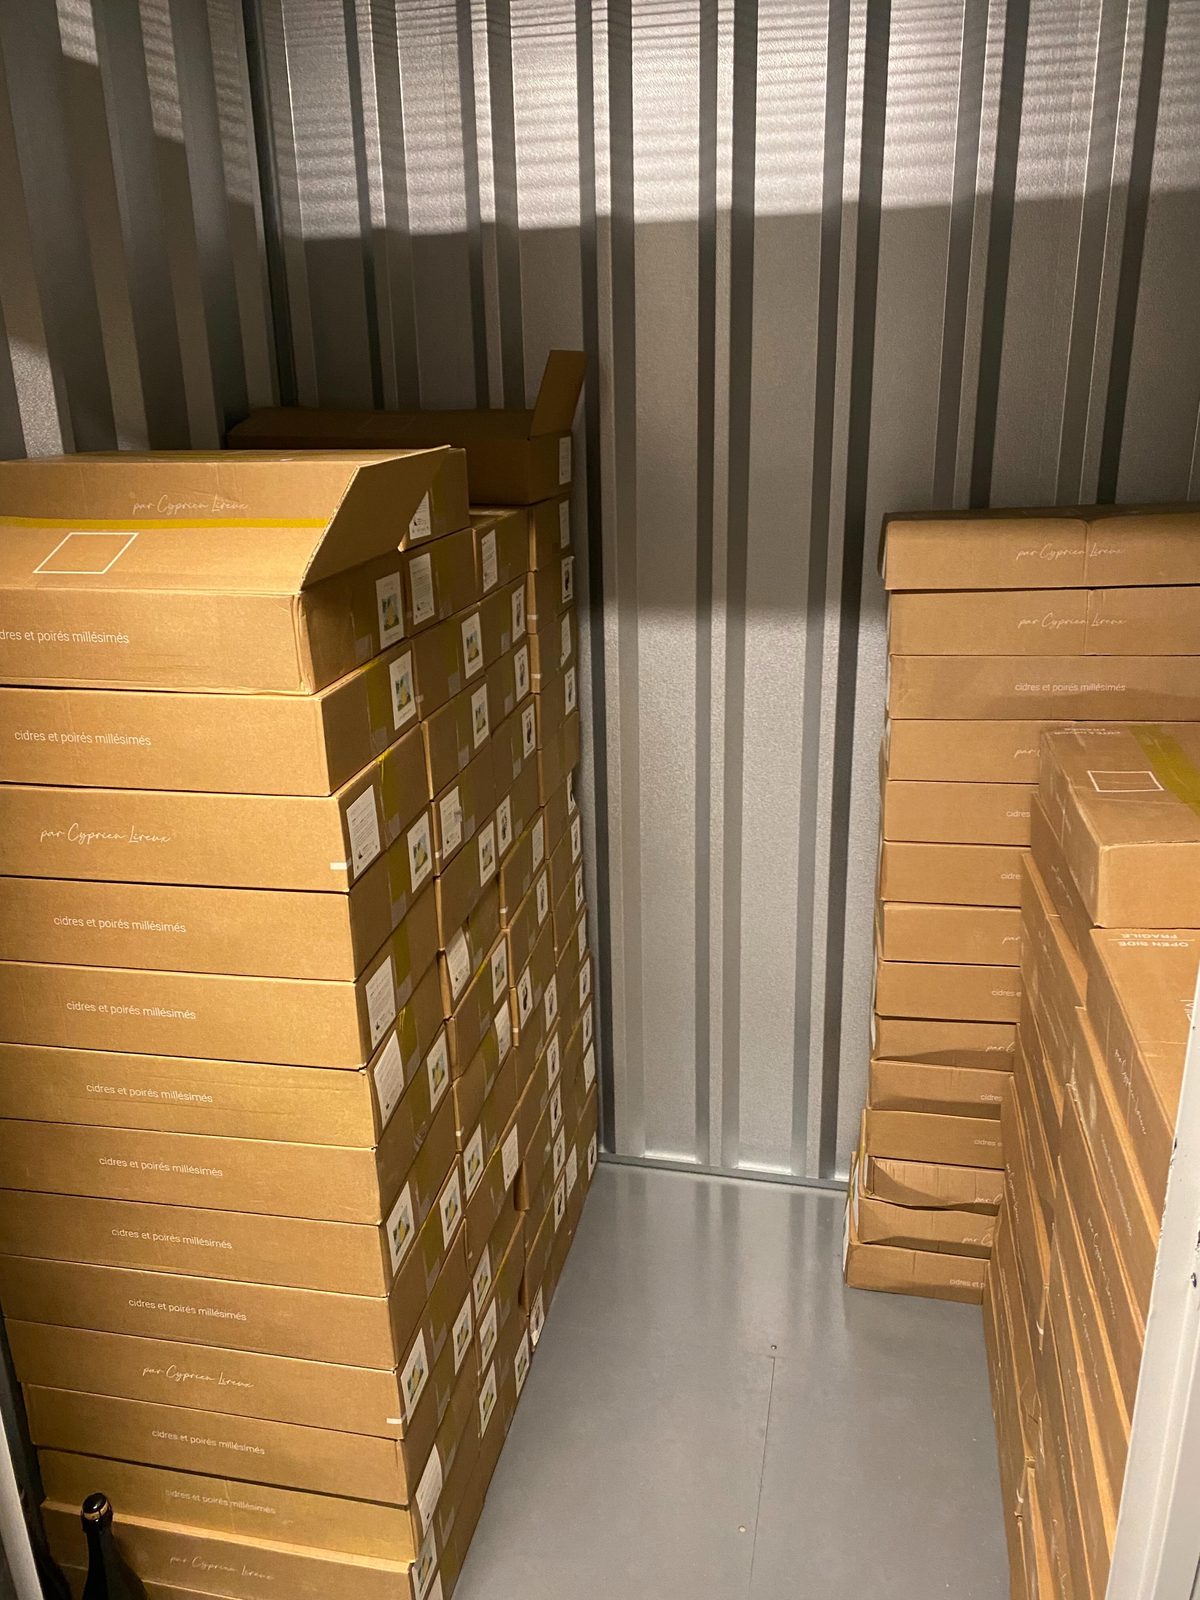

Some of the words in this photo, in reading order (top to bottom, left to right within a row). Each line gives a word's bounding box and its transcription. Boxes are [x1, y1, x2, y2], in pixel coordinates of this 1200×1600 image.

[132, 501, 155, 514] par
[0, 630, 22, 641] dres
[24, 631, 34, 641] et
[38, 631, 69, 644] poirés
[72, 631, 129, 644] millésimés
[15, 730, 45, 741] cidres
[48, 732, 58, 742] et
[61, 731, 93, 744] poirés
[95, 733, 151, 745] millésimés
[41, 830, 64, 842] par
[54, 916, 84, 926] cidres
[87, 917, 96, 927] et
[99, 918, 129, 931] poirés
[132, 920, 186, 932] millésimés
[67, 1001, 96, 1012] cidres
[98, 1003, 108, 1013] et
[111, 1004, 140, 1016] poirés
[143, 1006, 196, 1019] millésimés
[87, 1084, 115, 1094] cidres
[118, 1086, 127, 1096] et
[129, 1087, 158, 1099] poirés
[161, 1089, 213, 1102] millésimés
[99, 1157, 127, 1168] cidres
[129, 1160, 138, 1169] et
[141, 1160, 170, 1172] poirés
[172, 1163, 223, 1176] millésimés
[112, 1228, 139, 1238] cidres
[142, 1231, 150, 1240] et
[153, 1231, 180, 1244] poirés
[183, 1235, 232, 1249] millésimés
[129, 1298, 155, 1309] cidres
[157, 1301, 166, 1311] et
[169, 1302, 196, 1314] poirés
[198, 1305, 246, 1320] millésimés
[143, 1366, 163, 1376] par
[152, 1429, 178, 1440] cidres
[180, 1433, 188, 1442] et
[190, 1434, 216, 1447] poirés
[219, 1437, 265, 1455] millésimés
